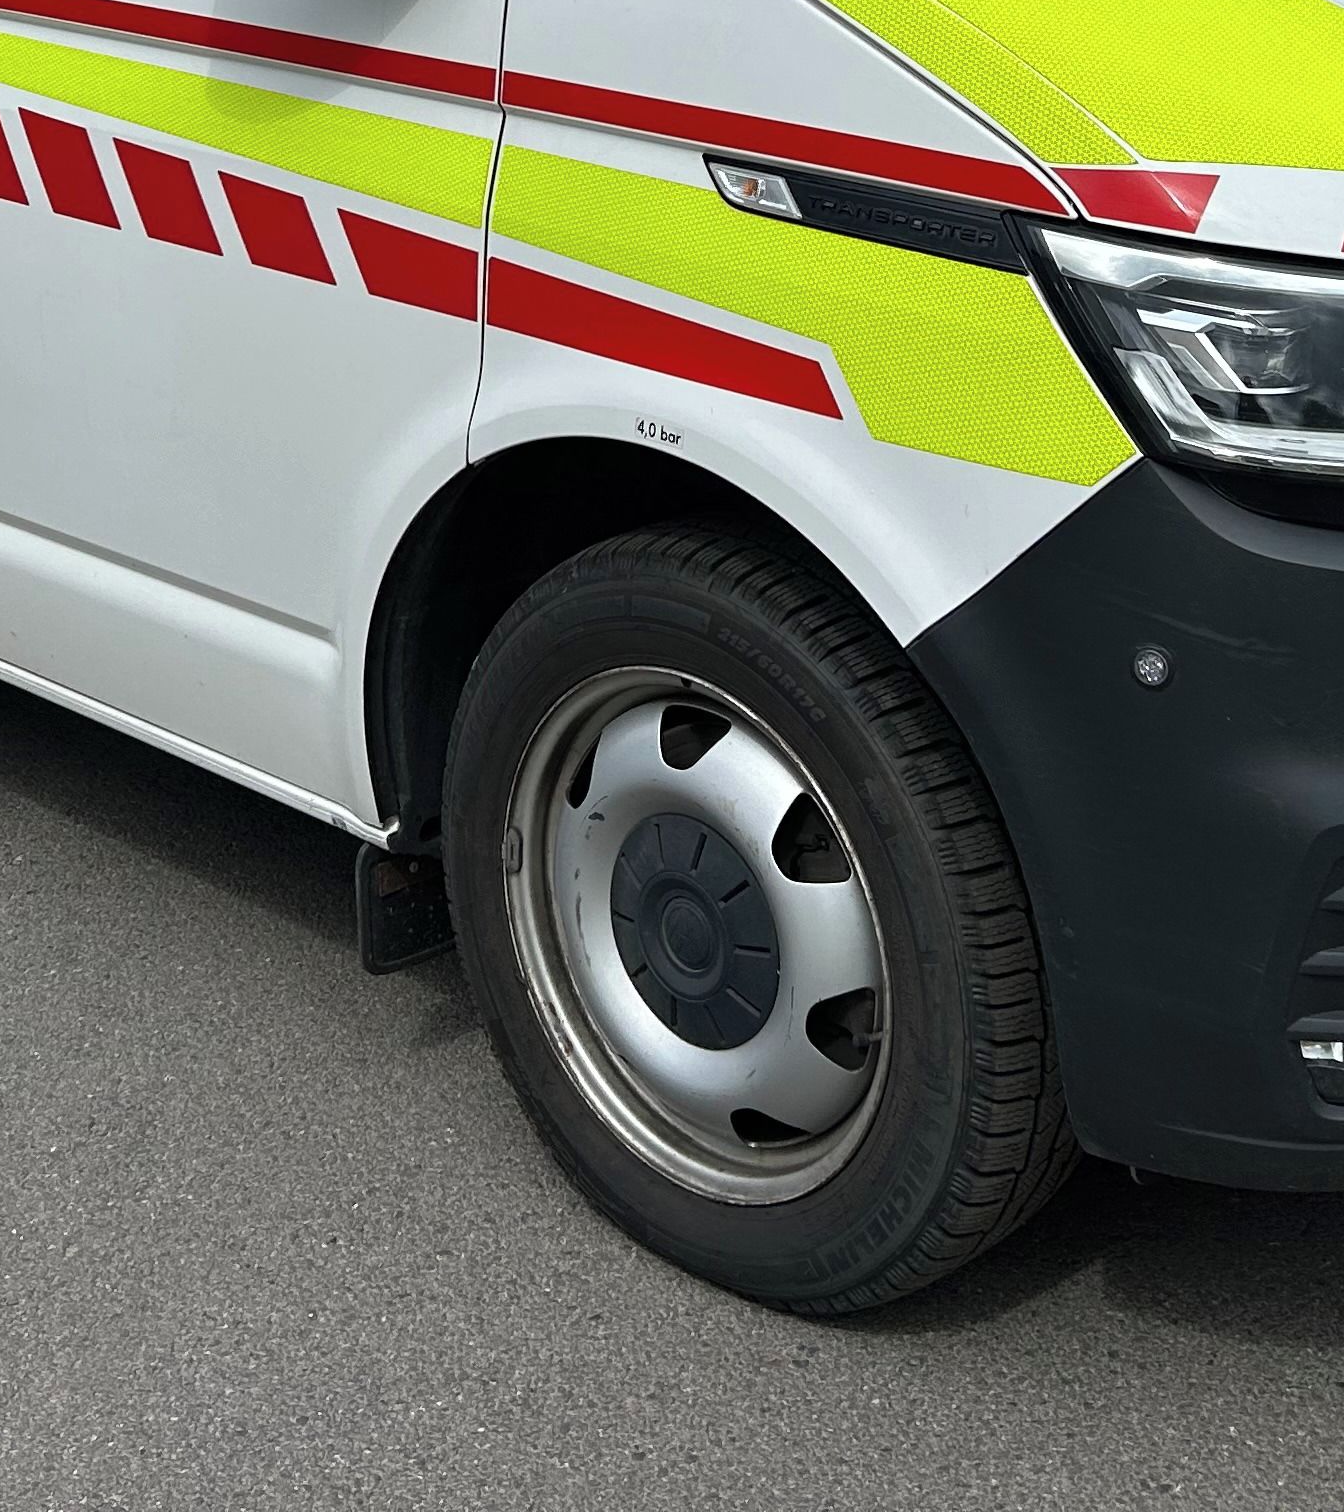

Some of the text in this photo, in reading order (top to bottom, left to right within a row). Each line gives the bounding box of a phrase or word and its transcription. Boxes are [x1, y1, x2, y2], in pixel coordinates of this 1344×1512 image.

[808, 196, 997, 248] TRANSPORTER
[637, 419, 682, 445] 4,0 bar
